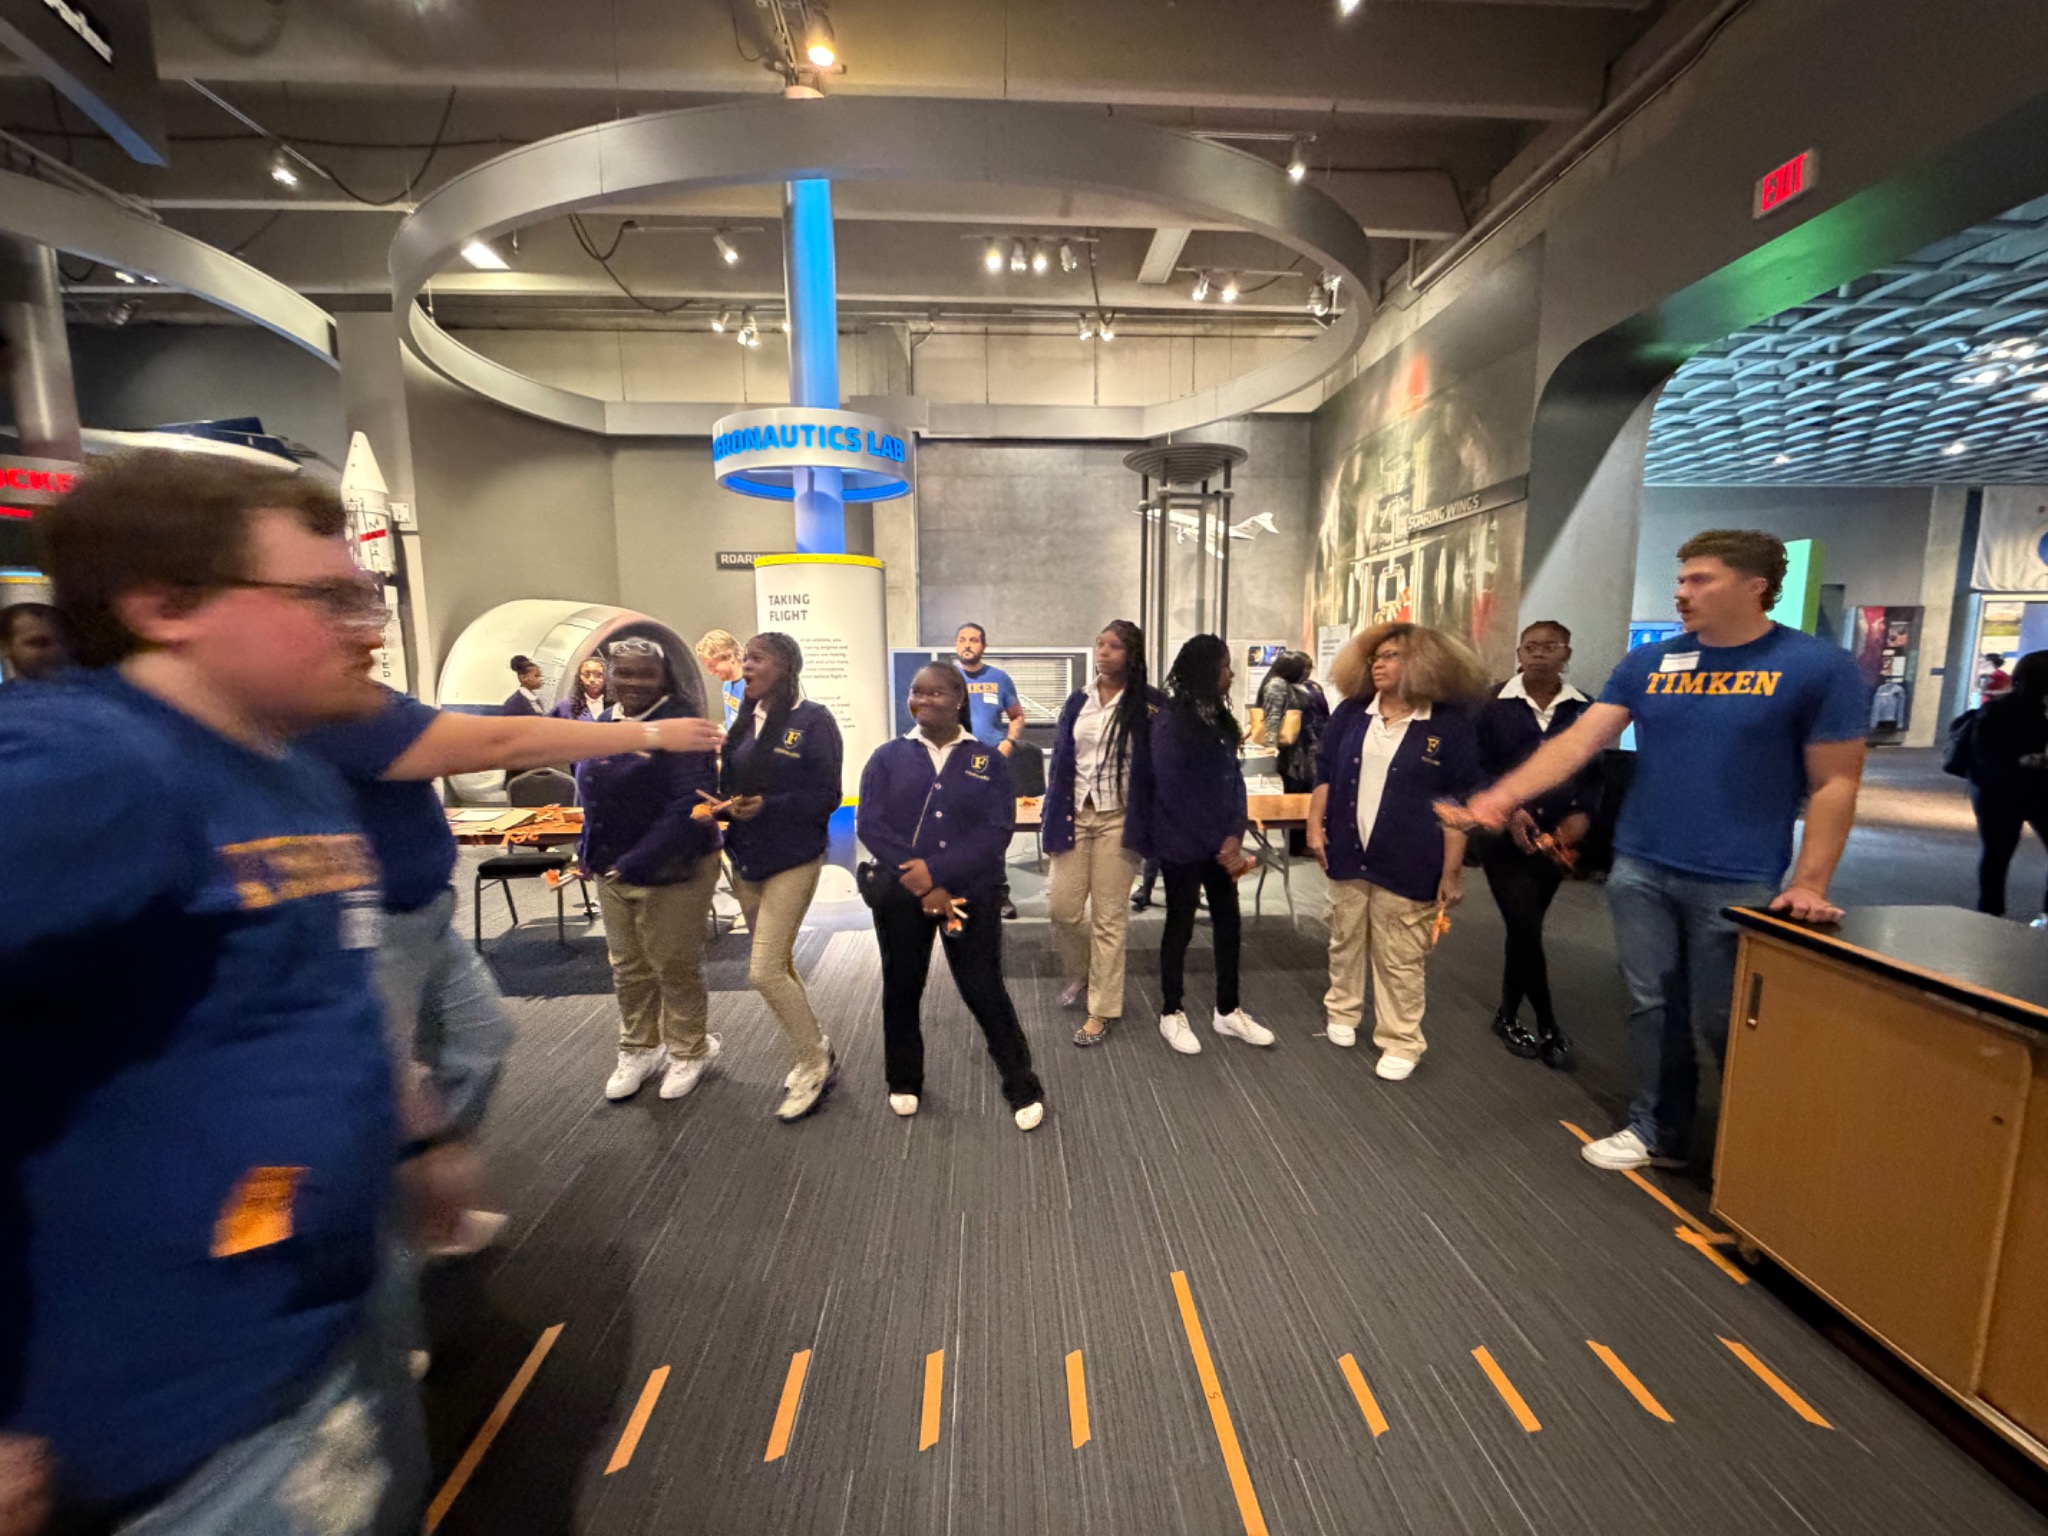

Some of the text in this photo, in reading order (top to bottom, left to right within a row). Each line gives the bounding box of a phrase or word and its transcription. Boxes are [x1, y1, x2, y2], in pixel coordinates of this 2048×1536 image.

[867, 431, 905, 463] LAB
[1446, 494, 1481, 518] WINGS
[768, 593, 810, 606] TAKING
[769, 610, 808, 622] FLIGHT
[1645, 671, 1782, 696] TIMKEN
